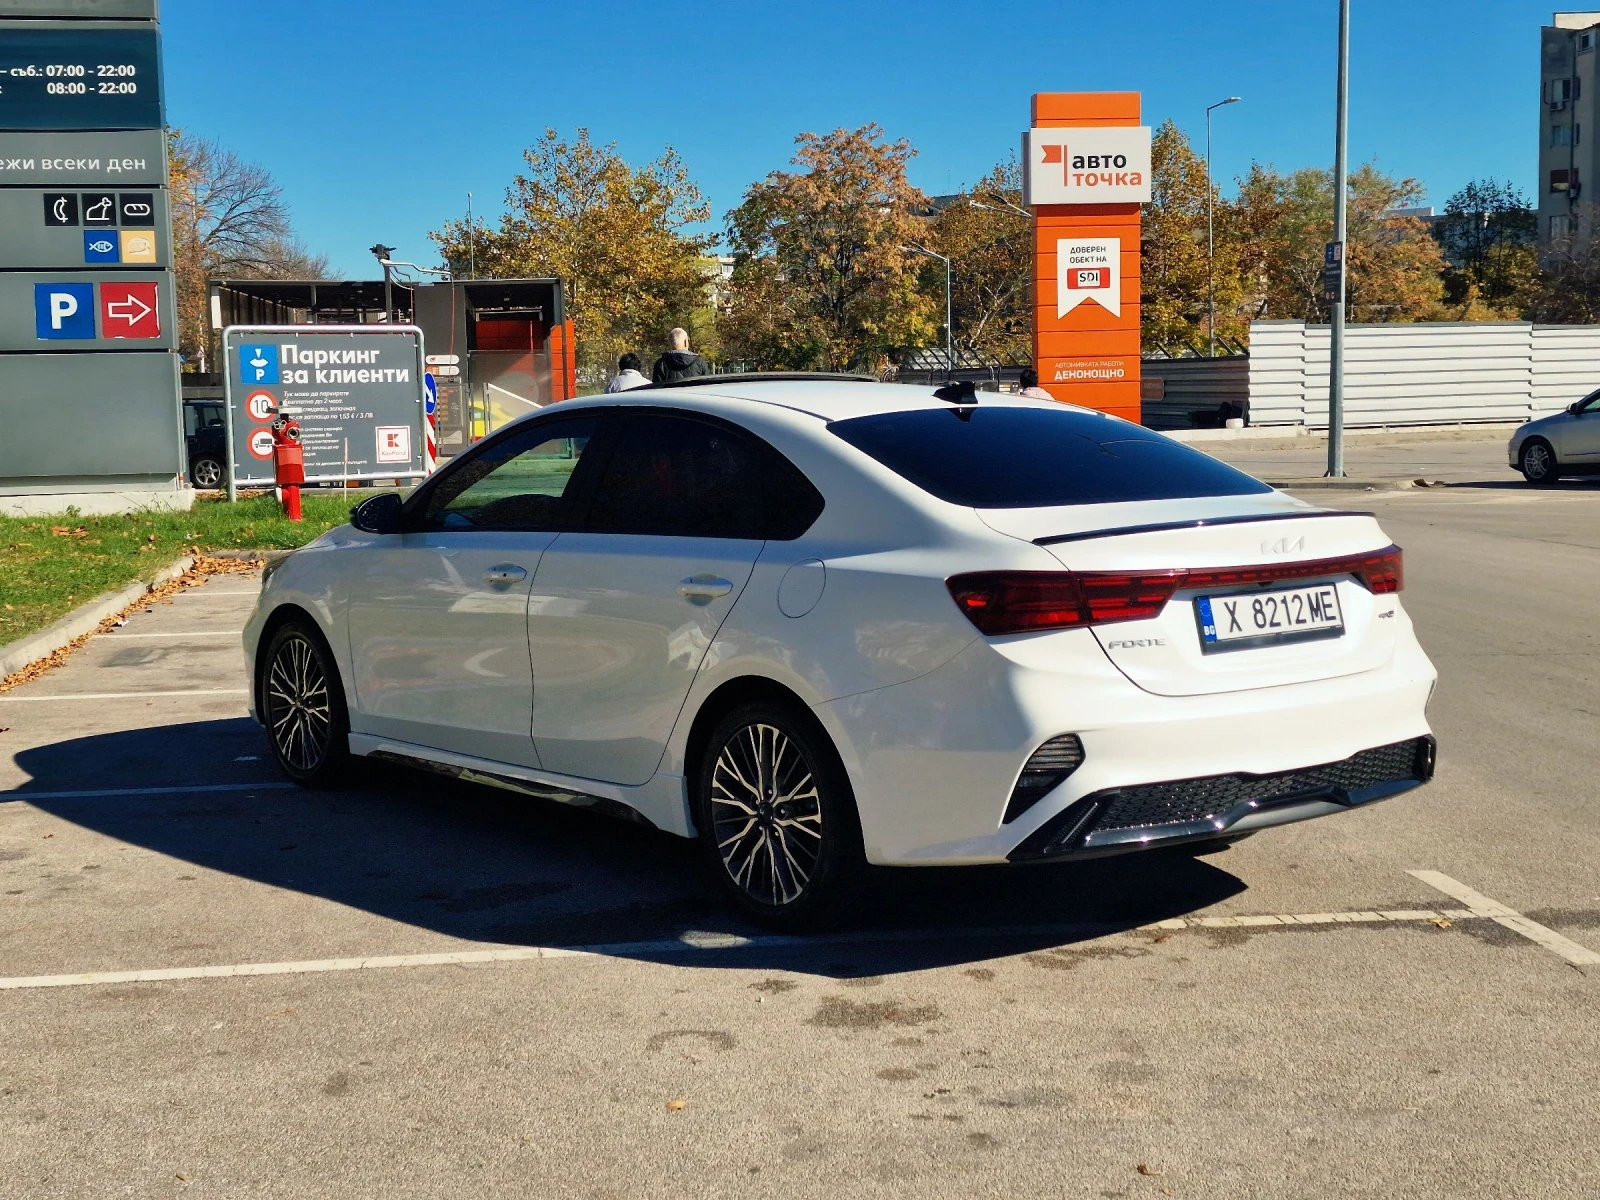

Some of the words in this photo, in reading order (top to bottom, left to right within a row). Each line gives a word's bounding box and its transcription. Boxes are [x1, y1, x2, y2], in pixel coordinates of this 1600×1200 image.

[46, 65, 85, 77] 07:00
[97, 65, 136, 77] 22:00
[47, 82, 86, 94] 08:00
[98, 82, 137, 94] 22:00
[42, 158, 100, 170] всеки
[107, 158, 146, 173] ден
[1072, 154, 1127, 170] авто
[1072, 172, 1142, 187] точка
[1070, 246, 1107, 254] ДОВЕРЕН
[1069, 256, 1094, 264] ОБЕКТ
[1079, 272, 1098, 283] SDI
[50, 293, 78, 330] P
[281, 344, 380, 369] Паркинг
[255, 369, 265, 381] P
[282, 369, 309, 384] за
[316, 368, 409, 384] клиенти
[1054, 369, 1125, 381] ДЕНОНОЩНО
[254, 399, 270, 414] 10
[1223, 600, 1243, 634] X
[1204, 625, 1216, 636] BG
[1108, 637, 1166, 650] FORTE
